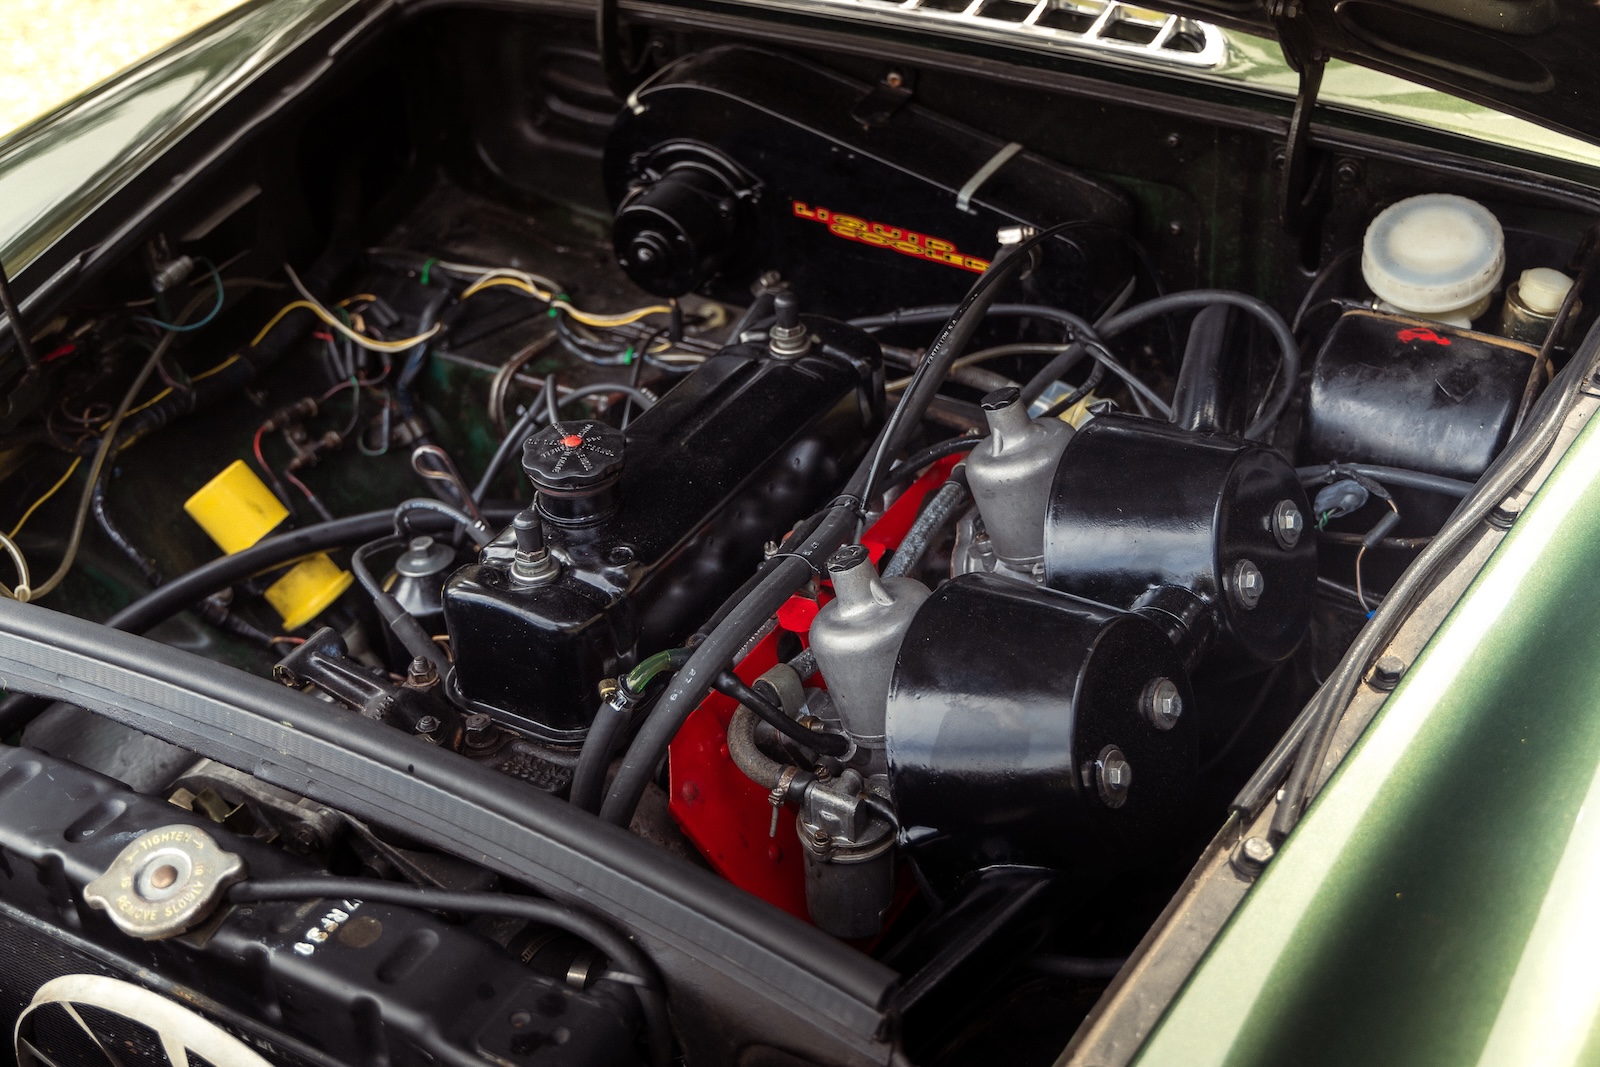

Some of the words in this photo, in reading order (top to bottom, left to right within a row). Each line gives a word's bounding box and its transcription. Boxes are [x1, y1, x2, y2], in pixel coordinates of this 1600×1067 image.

[794, 202, 955, 252] LIQUID
[140, 831, 192, 850] TIGHTEN
[116, 894, 158, 921] REMOVE
[164, 881, 204, 918] SLOWLY
